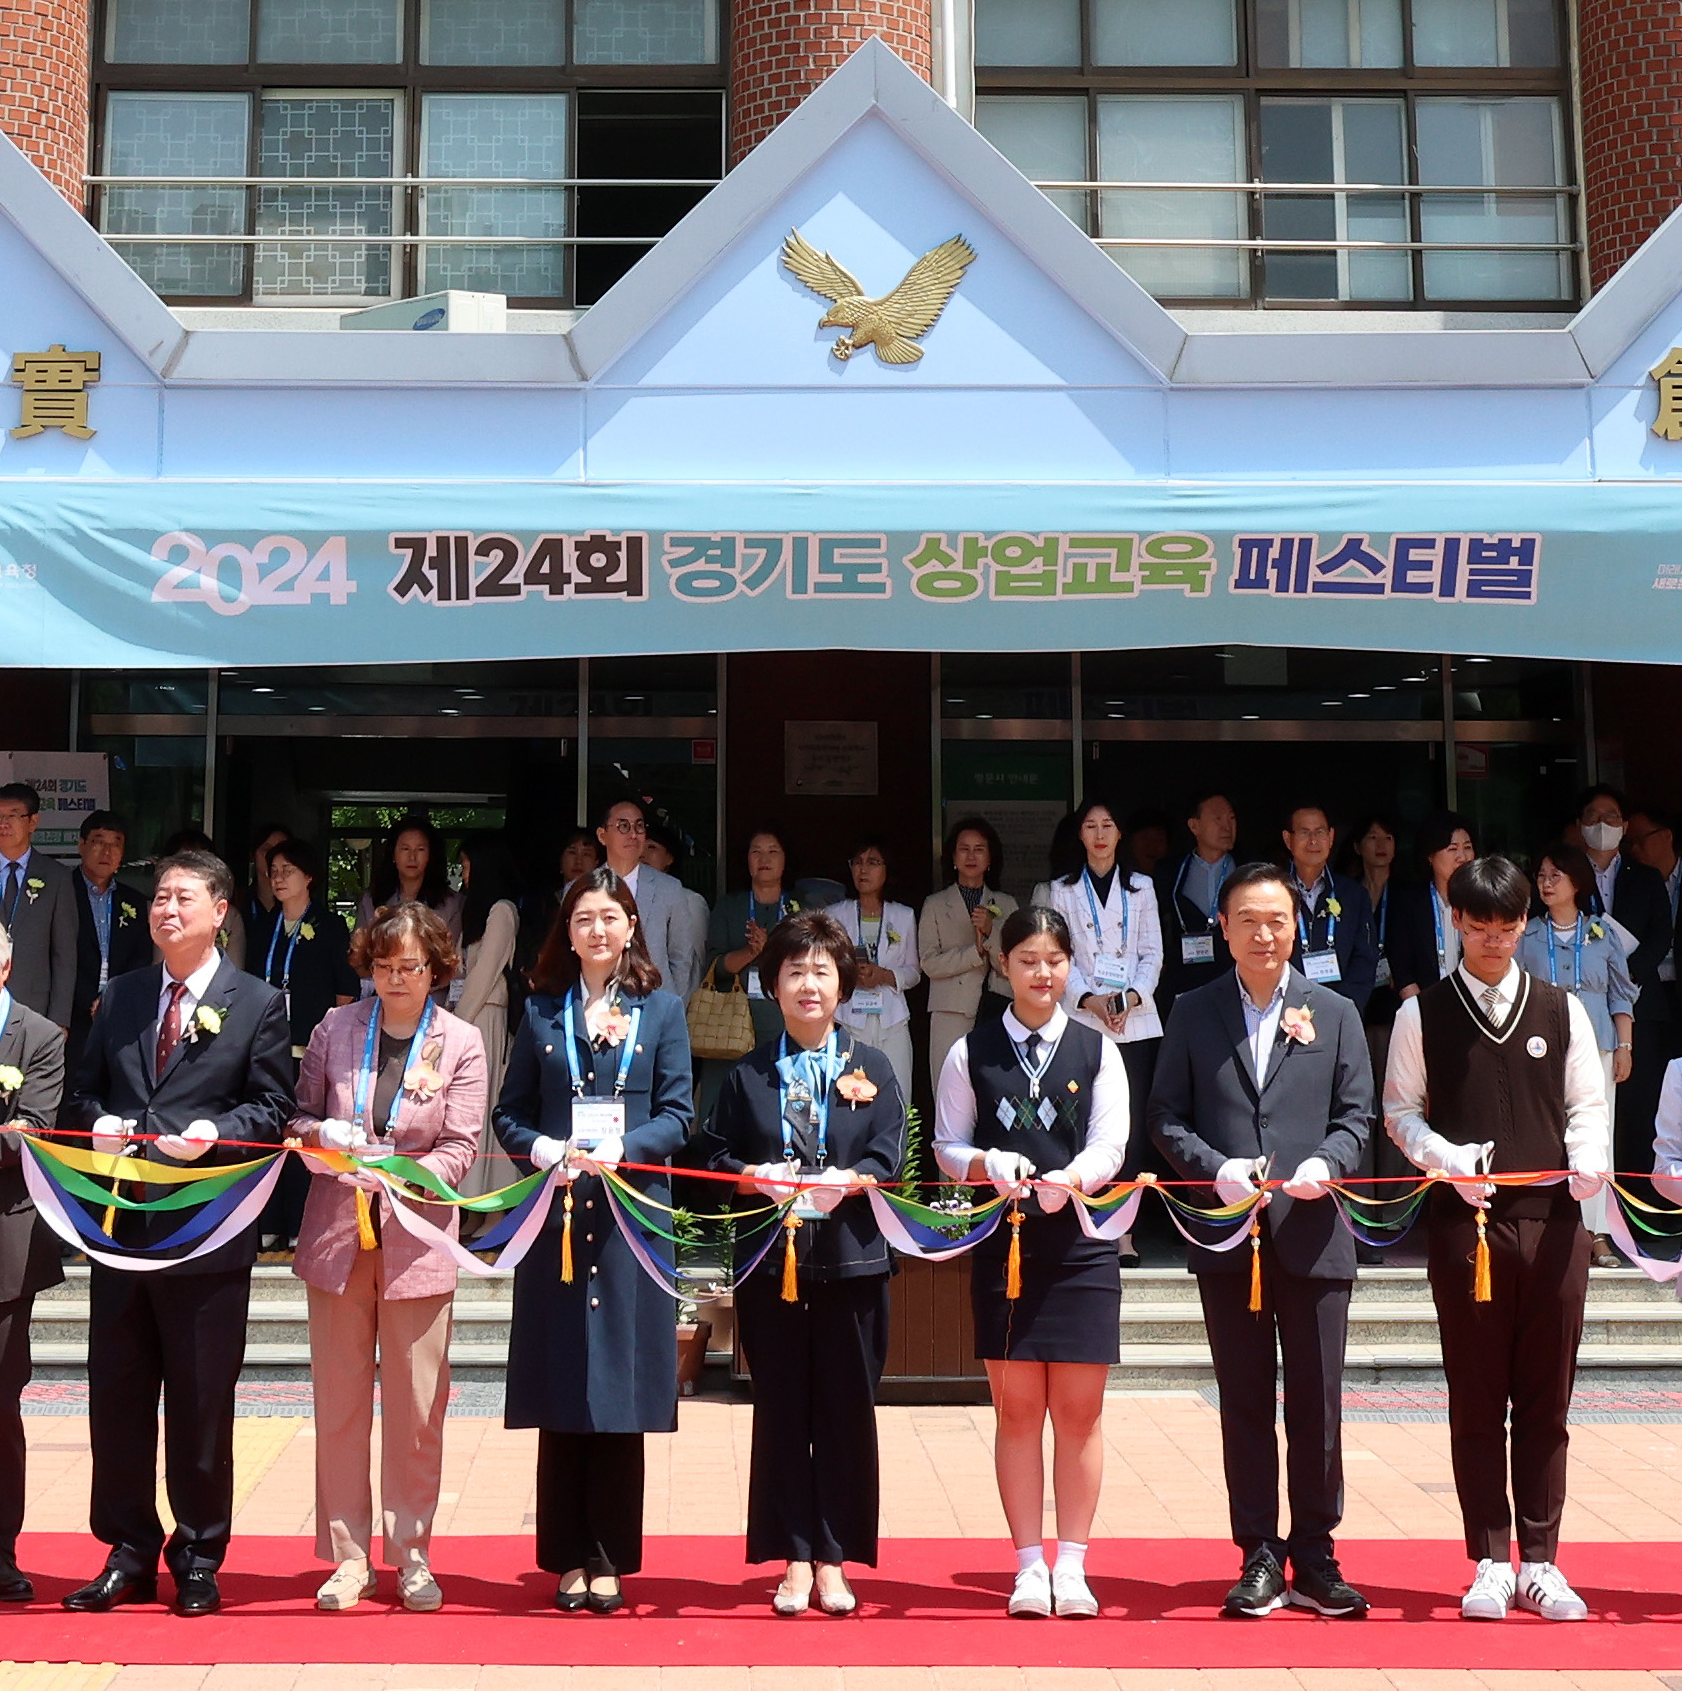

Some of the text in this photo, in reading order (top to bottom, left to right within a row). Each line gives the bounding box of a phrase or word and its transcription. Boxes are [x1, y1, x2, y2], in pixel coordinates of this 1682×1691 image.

[150, 531, 1538, 616] 2024 제24회 경기도 상업교육 페스티벌
